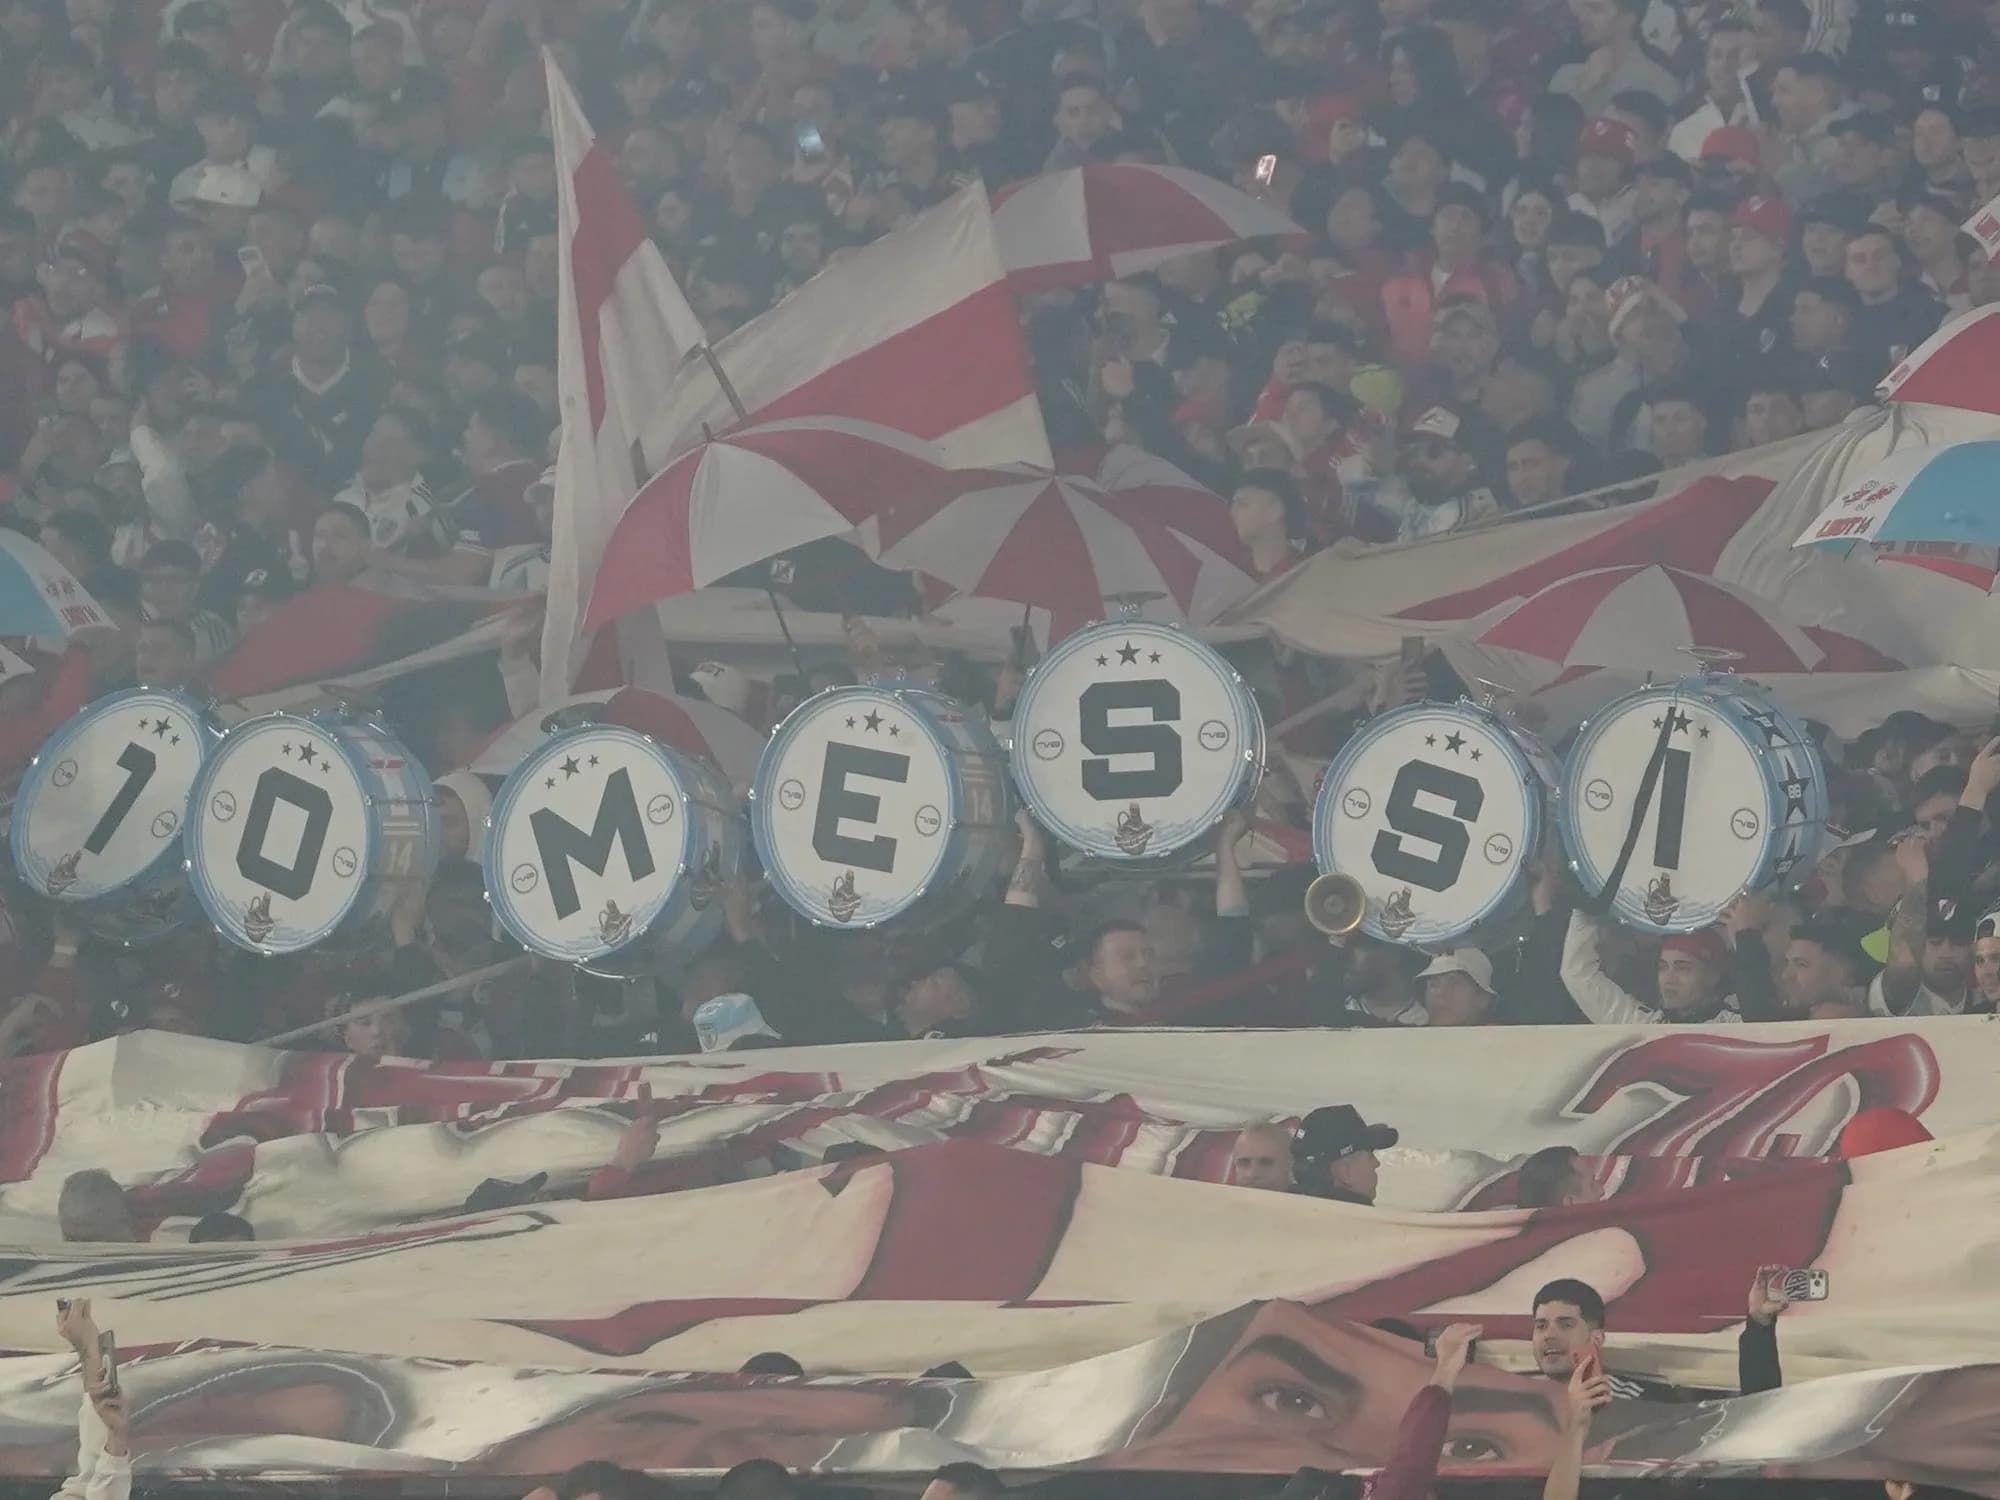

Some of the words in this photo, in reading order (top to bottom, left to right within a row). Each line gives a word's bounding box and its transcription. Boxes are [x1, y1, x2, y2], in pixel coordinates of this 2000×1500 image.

[82, 742, 156, 856] 1
[236, 767, 333, 901] 0
[530, 767, 655, 920] M
[812, 741, 910, 873] E
[1079, 679, 1182, 800] S
[1371, 759, 1484, 892] S
[1653, 748, 1691, 870] I
